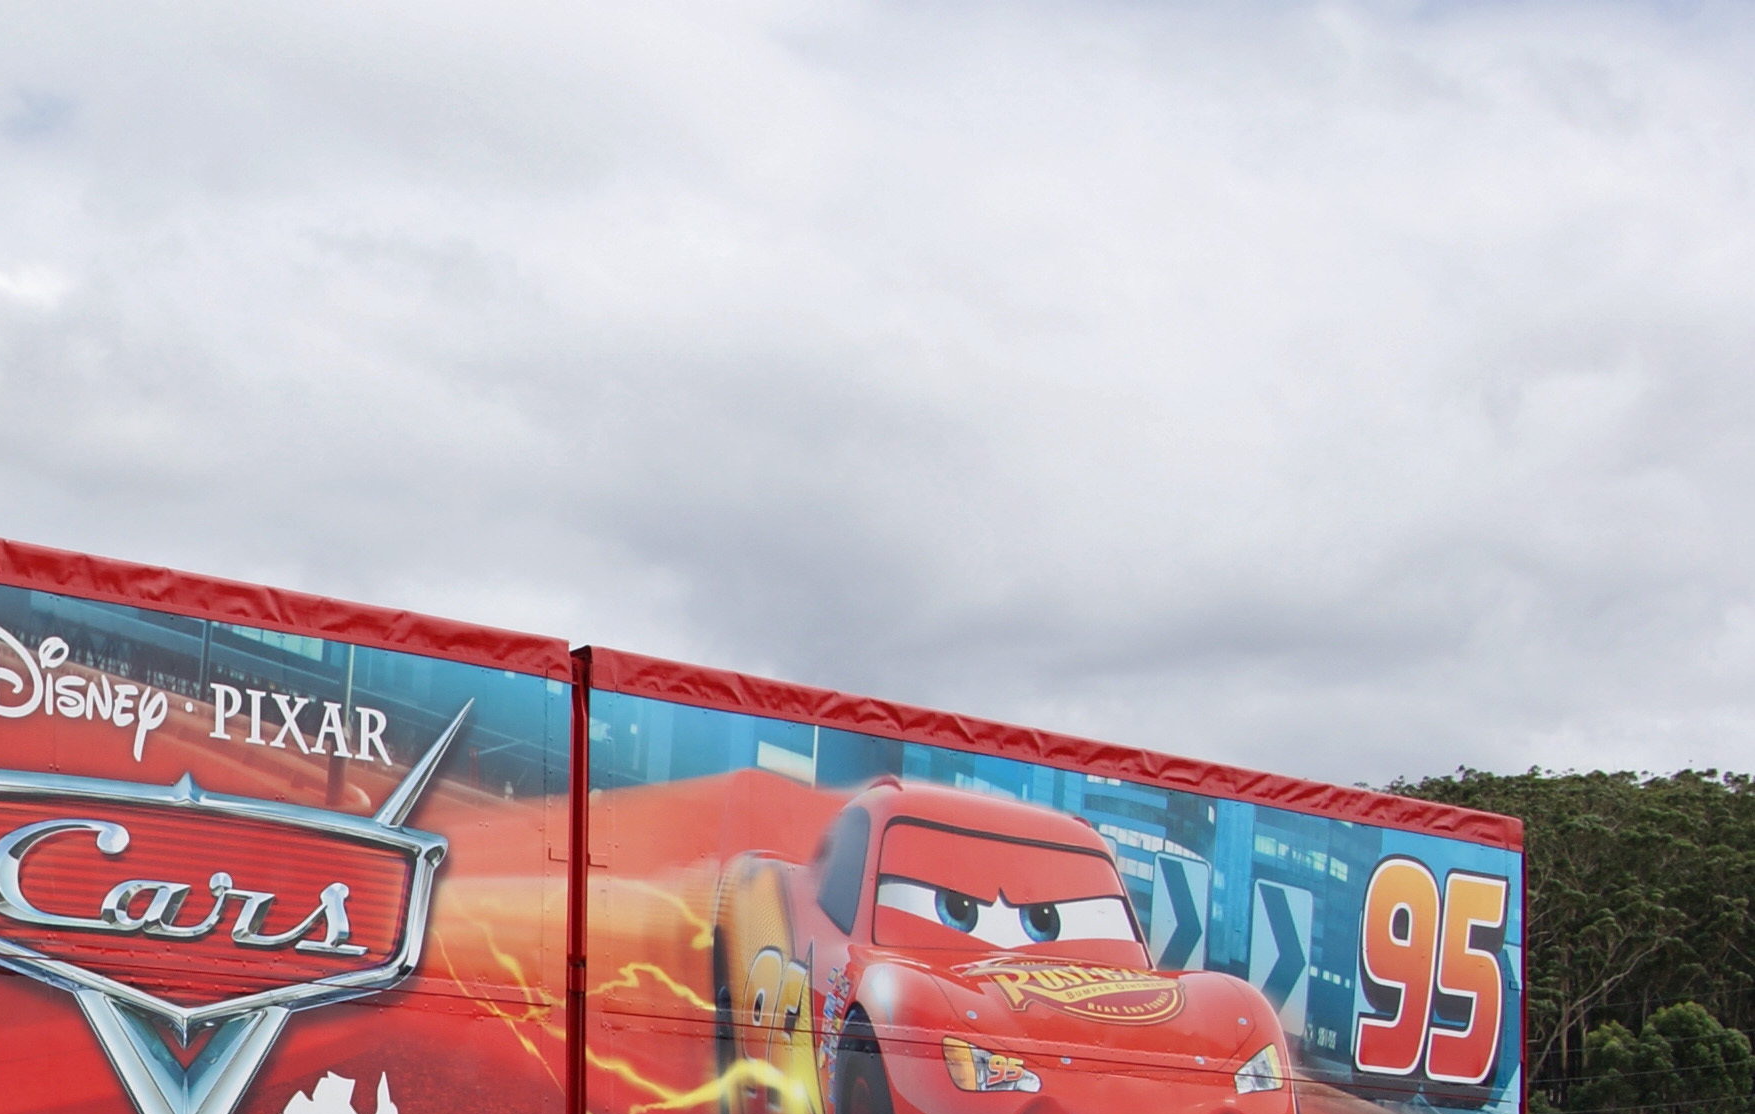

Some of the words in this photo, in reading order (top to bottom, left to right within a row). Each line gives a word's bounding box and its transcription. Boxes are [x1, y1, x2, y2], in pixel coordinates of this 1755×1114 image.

[209, 682, 393, 766] PIXAR
[1354, 856, 1508, 1085] 95
[986, 1054, 1024, 1086] 95
